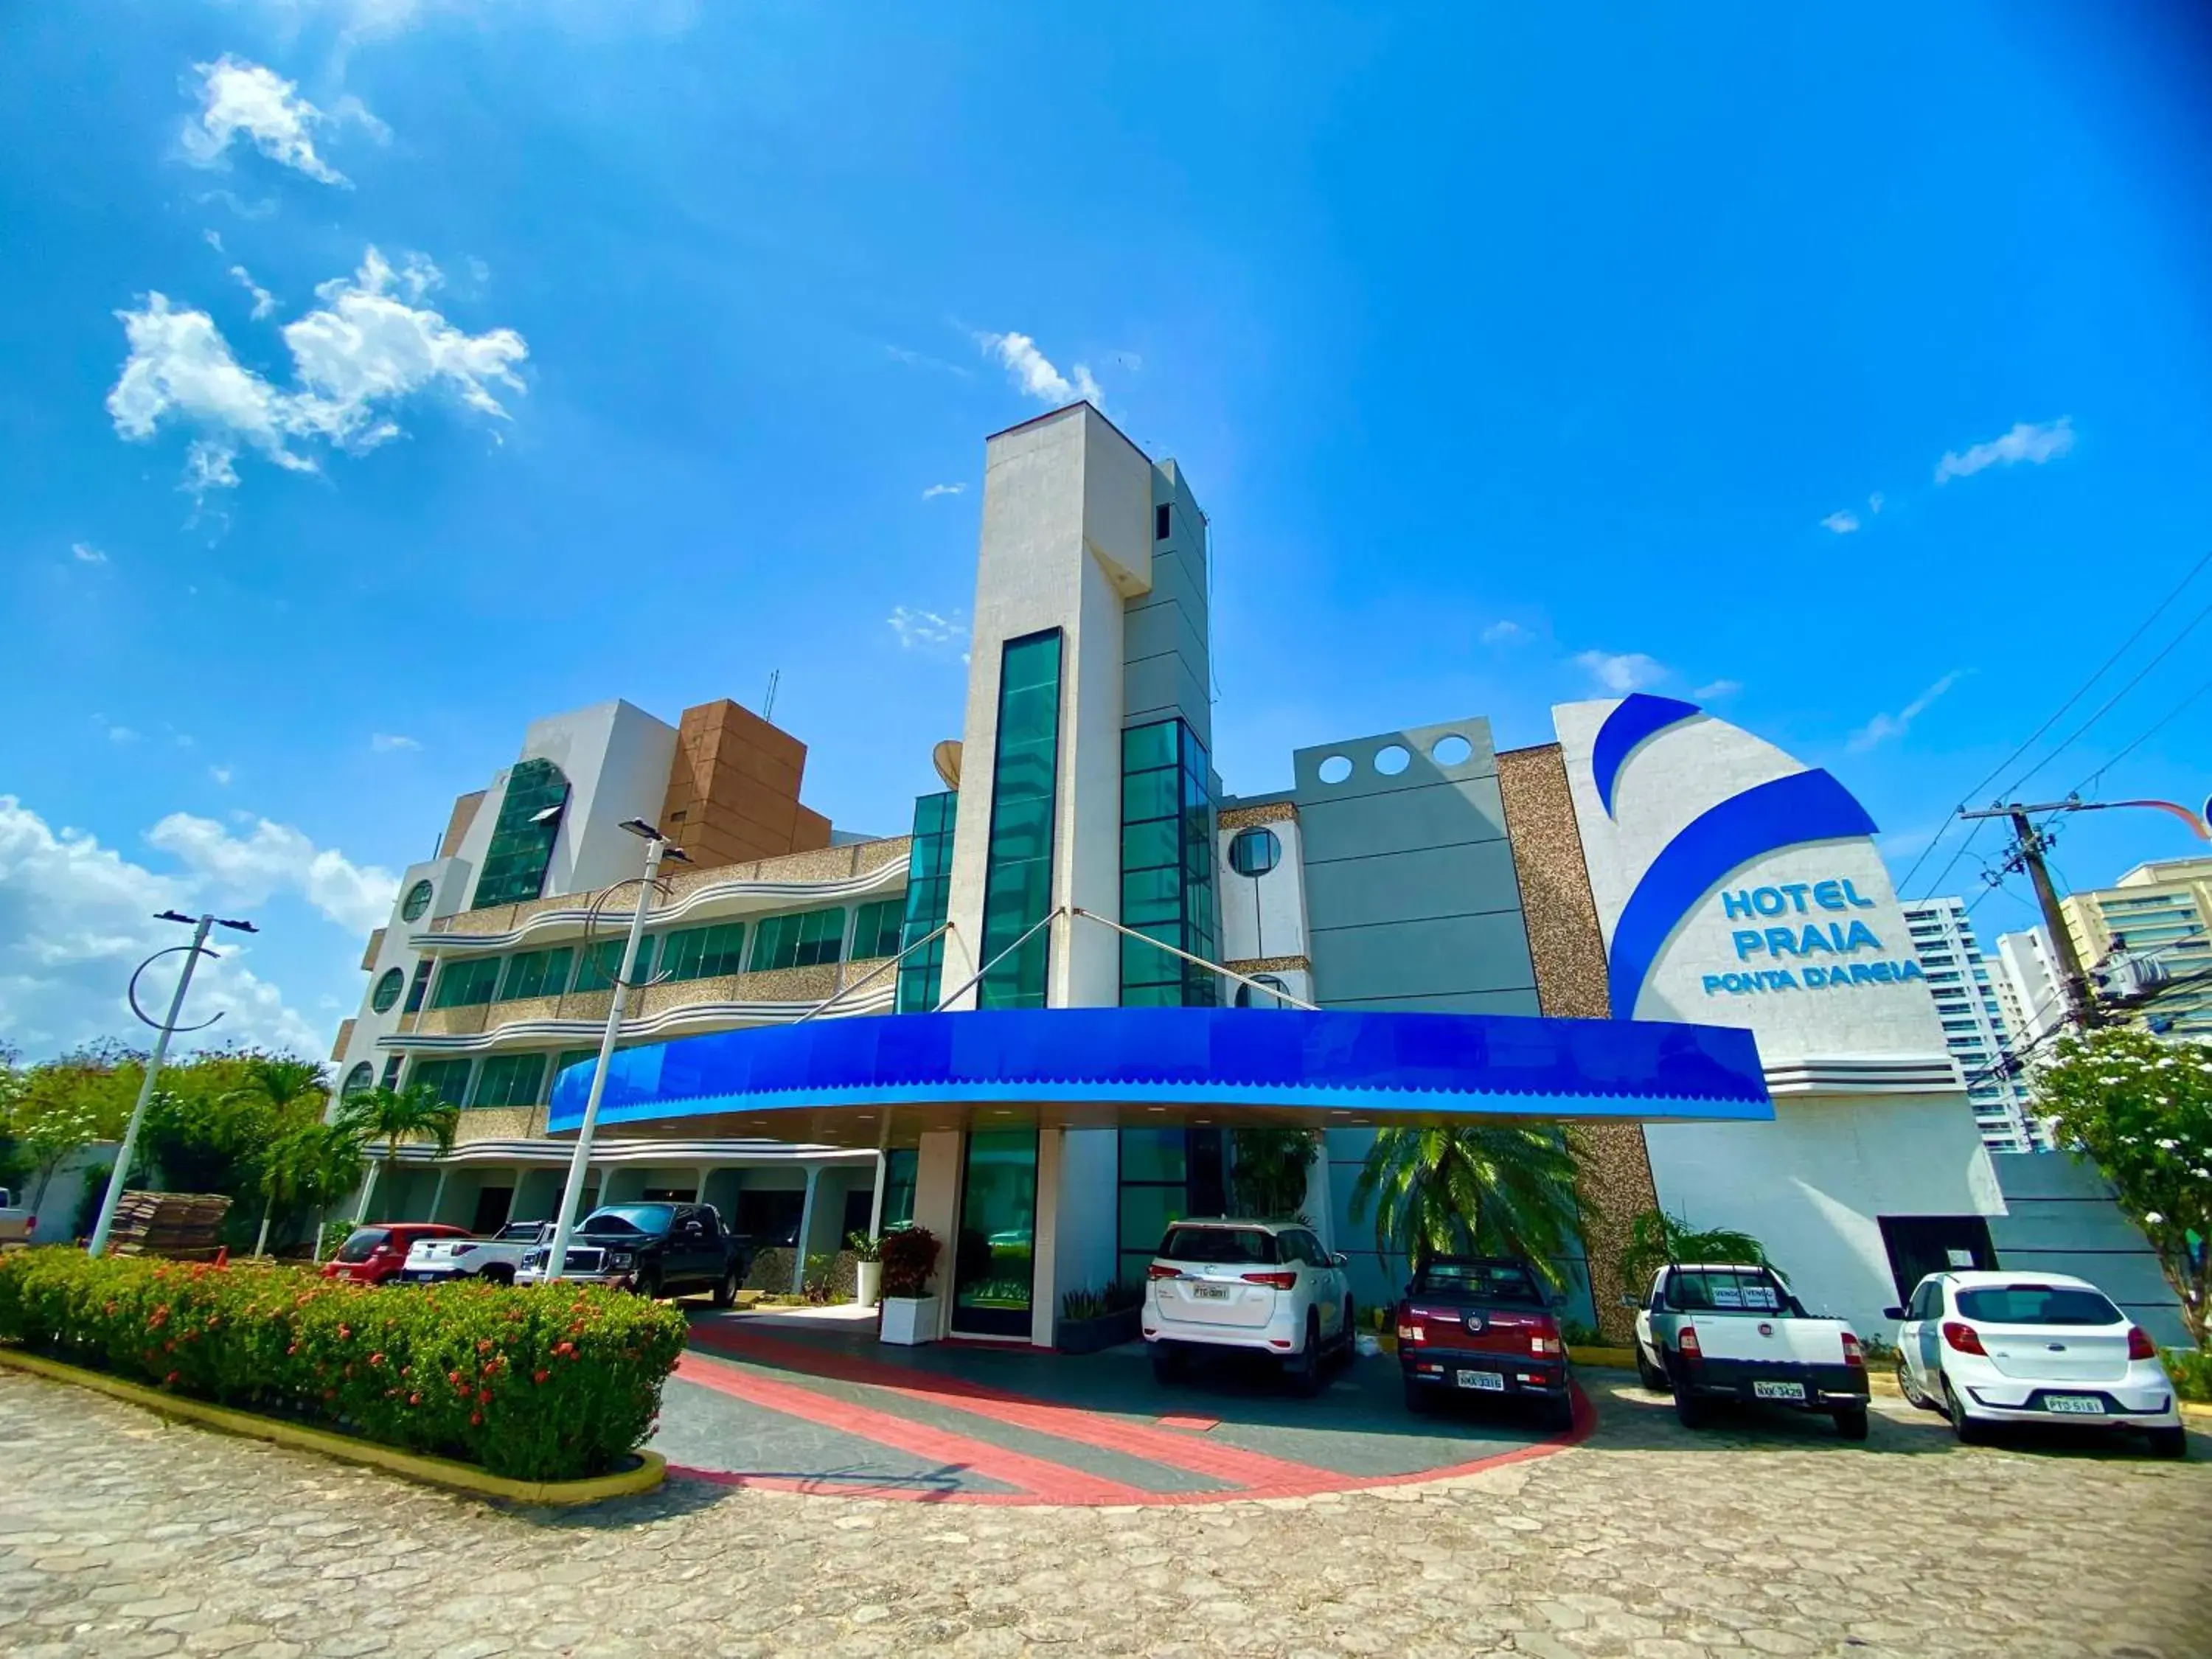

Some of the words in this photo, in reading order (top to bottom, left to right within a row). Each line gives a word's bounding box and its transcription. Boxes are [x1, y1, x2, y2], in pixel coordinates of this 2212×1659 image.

[1722, 877, 1875, 919] HOTEL
[1731, 919, 1883, 960] PRAIA
[1702, 968, 1799, 996] PONTA
